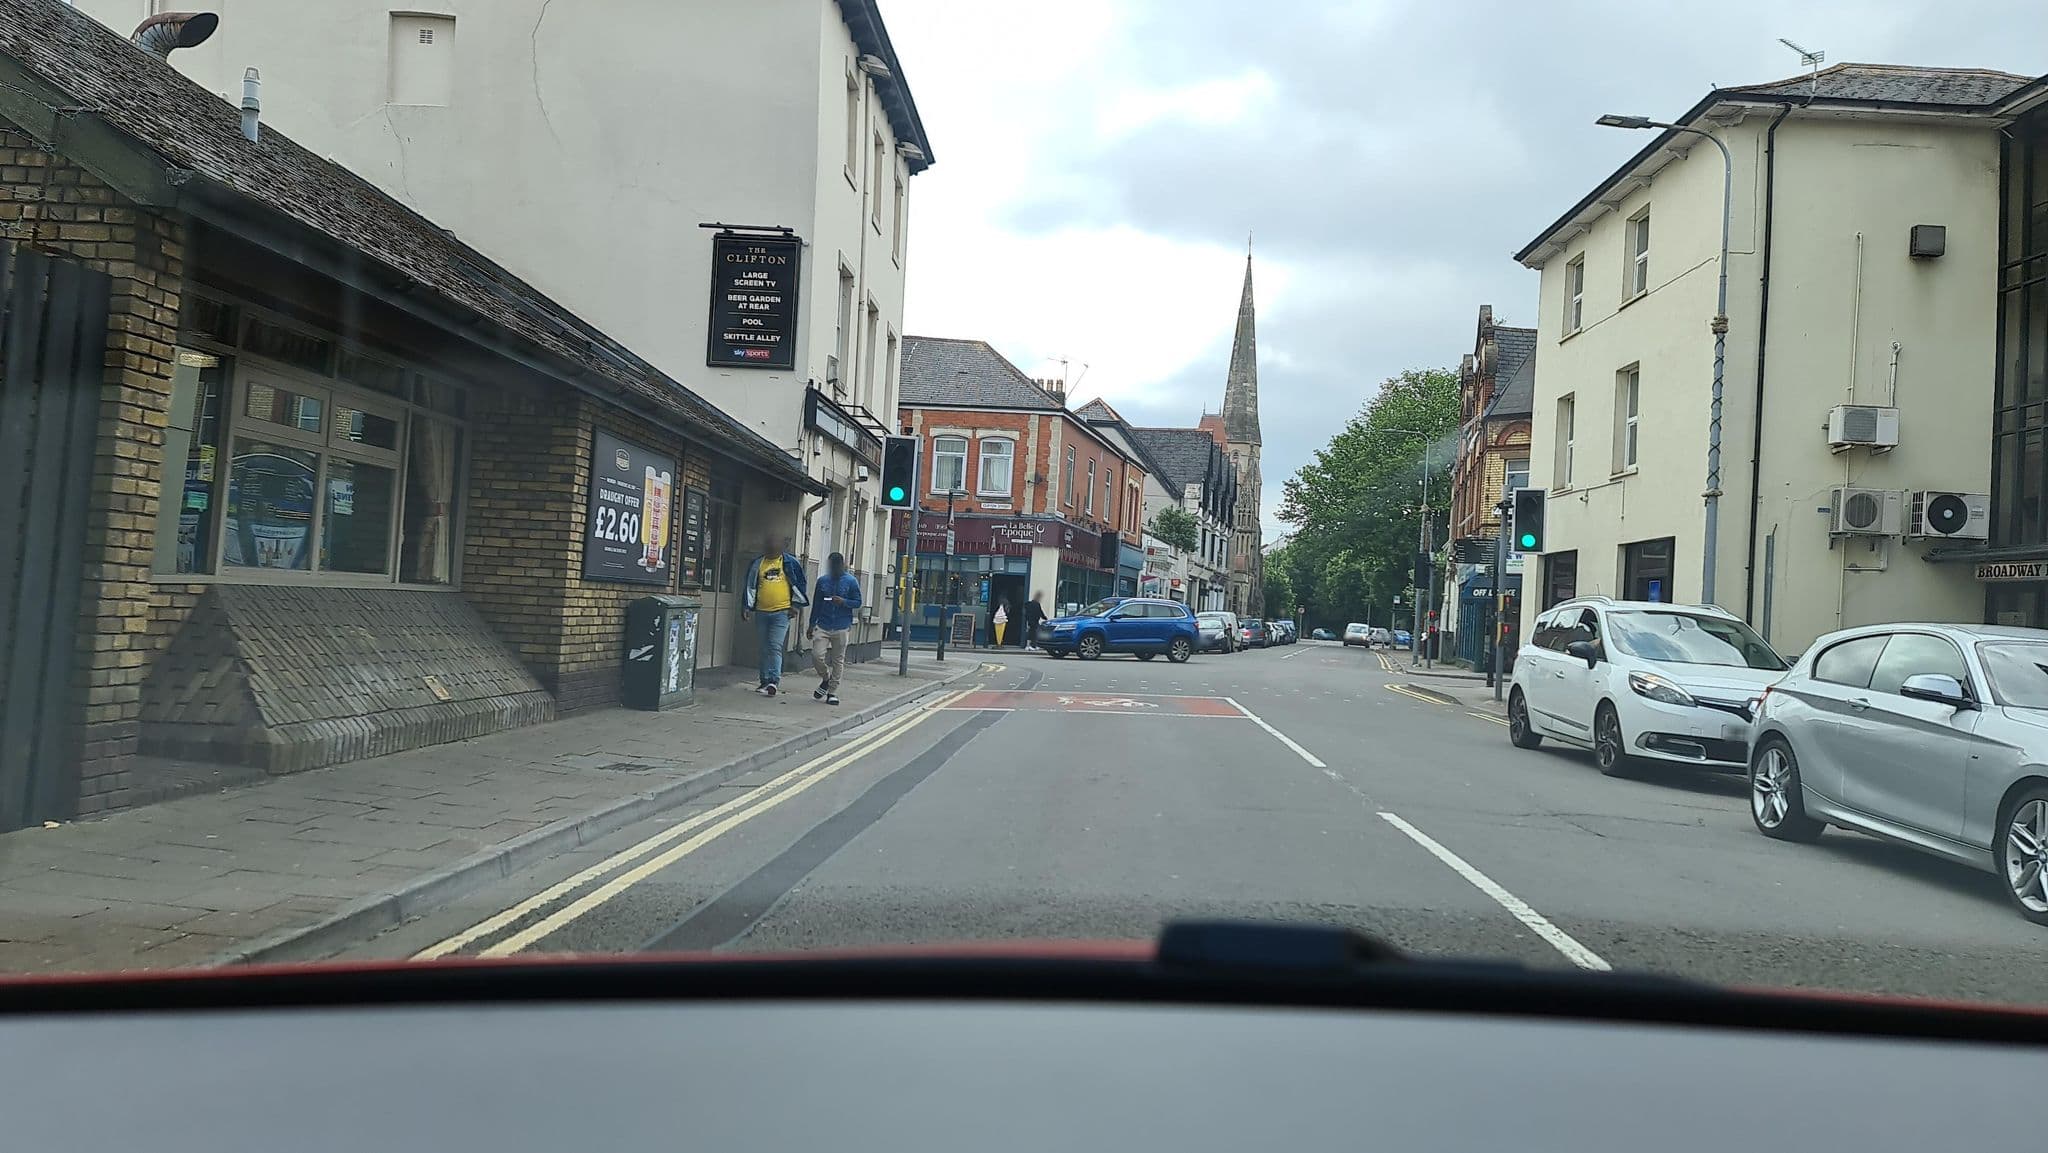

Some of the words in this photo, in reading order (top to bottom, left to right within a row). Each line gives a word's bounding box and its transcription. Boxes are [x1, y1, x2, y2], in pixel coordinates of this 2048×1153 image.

[726, 254, 786, 265] CLIFTON
[734, 279, 764, 287] SCREEN
[728, 294, 748, 302] BEER
[749, 295, 781, 303] GARDEN
[742, 318, 764, 326] POOL
[723, 333, 755, 341] SKITTLE
[756, 334, 781, 342] ALLEY
[733, 349, 745, 357] sky
[745, 350, 769, 358] sports
[599, 488, 625, 505] DRAUGHT
[624, 495, 640, 508] OFFER
[1018, 522, 1034, 530] Belle
[1977, 564, 2042, 578] BROADWAY
[1472, 588, 1488, 597] OFF
